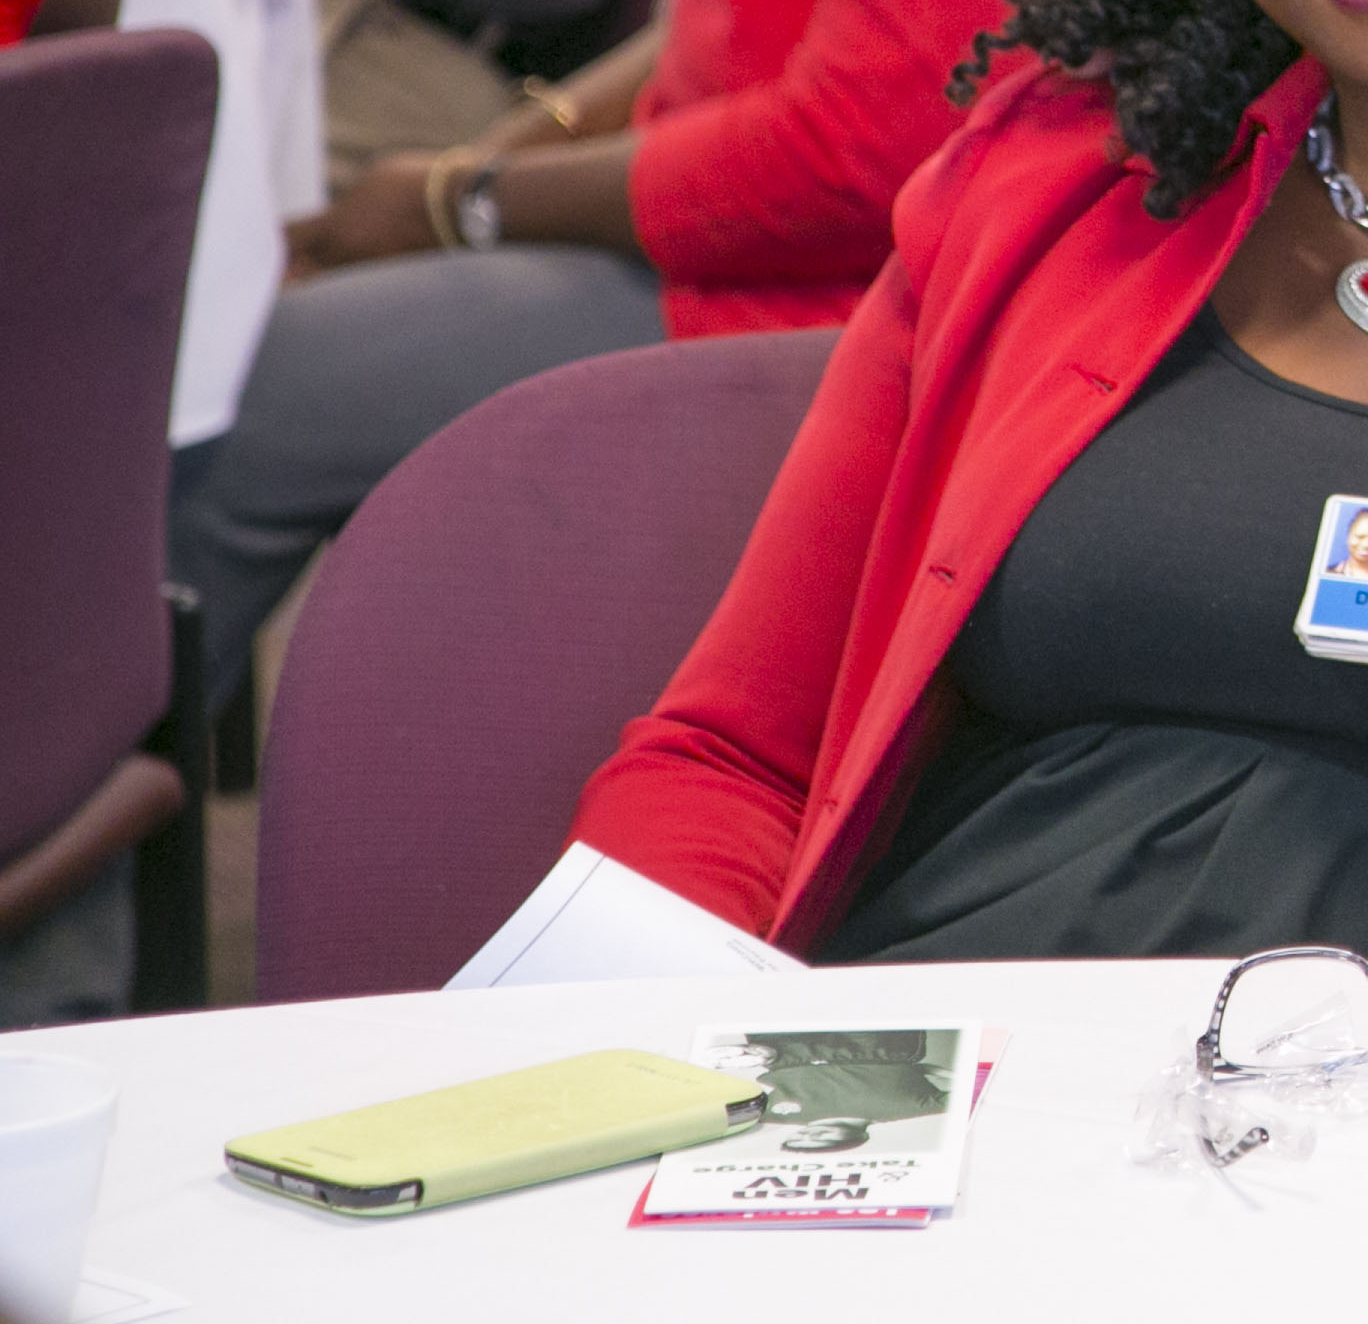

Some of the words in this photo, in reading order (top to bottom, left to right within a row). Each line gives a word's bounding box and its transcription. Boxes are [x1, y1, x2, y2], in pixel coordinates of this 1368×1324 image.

[692, 1162, 825, 1173] Charge
[837, 1160, 921, 1168] Take
[744, 1173, 862, 1188] HIV
[732, 1187, 869, 1201] Men
